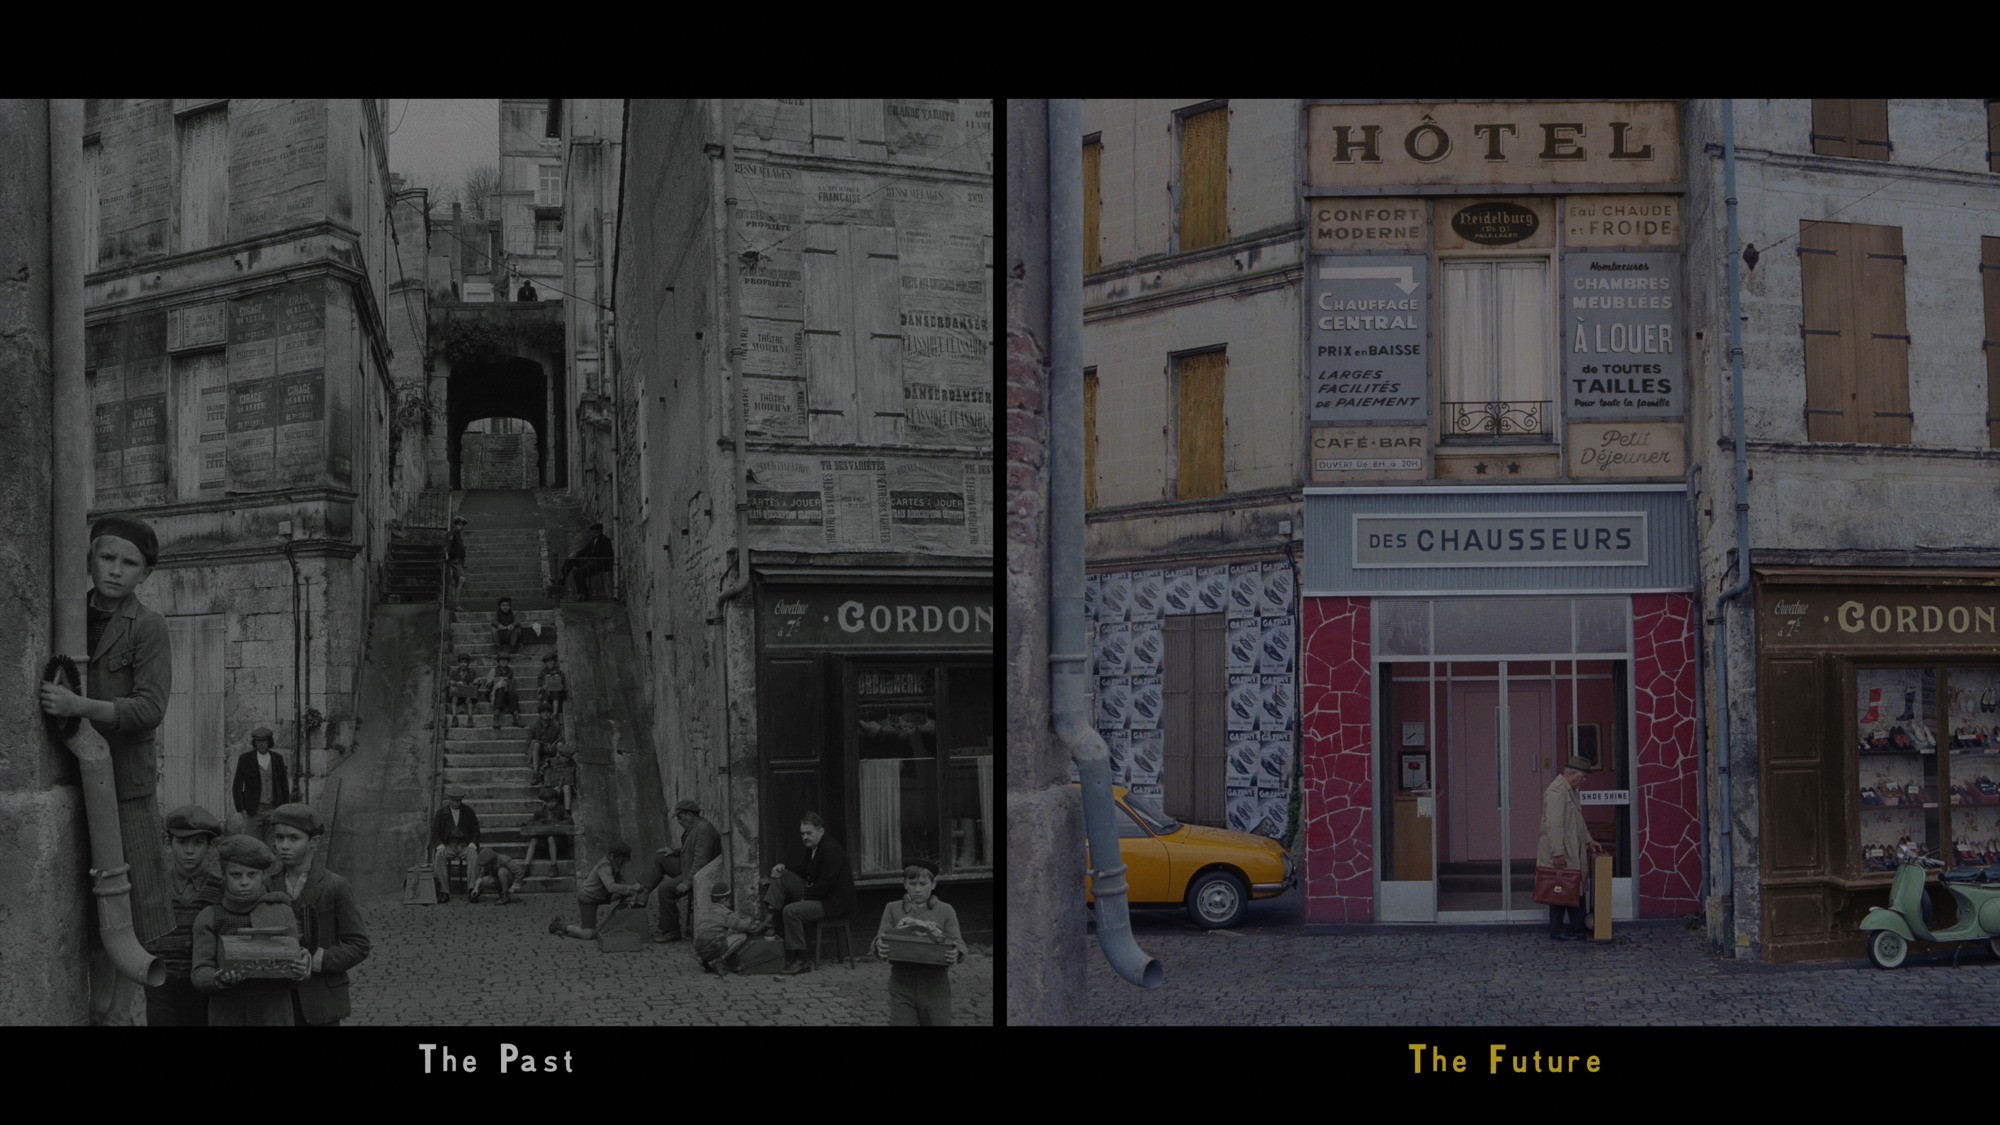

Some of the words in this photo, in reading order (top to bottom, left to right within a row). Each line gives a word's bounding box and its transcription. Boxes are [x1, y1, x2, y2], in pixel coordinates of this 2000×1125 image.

[1332, 113, 1655, 165] HÔTEL
[1317, 208, 1420, 222] CONFORT
[1569, 206, 1595, 217] Eau
[1602, 205, 1672, 217] CHAUDE
[1460, 211, 1534, 226] Heidelburg
[1317, 226, 1420, 240] MODERNE
[1571, 227, 1584, 235] et
[1590, 221, 1671, 235] FROIDE
[1590, 261, 1650, 271] Nombreuses
[1573, 277, 1671, 290] CHAMBRES
[1573, 292, 1673, 310] MEUBLÉES
[1318, 315, 1418, 331] CENTRAL
[1572, 317, 1589, 353] À
[1596, 322, 1673, 354] LOUER
[1318, 346, 1352, 357] PRIX
[1369, 345, 1420, 356] BAISSE
[1318, 370, 1383, 380] LARGES
[1582, 364, 1598, 374] de
[1602, 364, 1662, 374] TOUTES
[1318, 381, 1401, 393] FACILITÉS
[1573, 379, 1672, 394] TAILLES
[1335, 397, 1420, 407] PAIEMENT
[1574, 399, 1595, 407] Pour
[1600, 399, 1620, 407] toute
[1624, 399, 1634, 407] la
[1637, 399, 1670, 409] famille
[1314, 436, 1368, 448] CAFÉ
[1380, 437, 1422, 448] BAR
[1601, 430, 1651, 447] Petit
[1319, 461, 1353, 469] OUVERT
[1580, 447, 1671, 471] Déjeuner
[790, 499, 822, 507] JOUER
[892, 498, 925, 507] CARTES
[935, 500, 964, 508] JOUER
[1369, 533, 1407, 549] DES
[1416, 527, 1633, 552] CHAUSSEURS
[1604, 792, 1627, 800] SHINE
